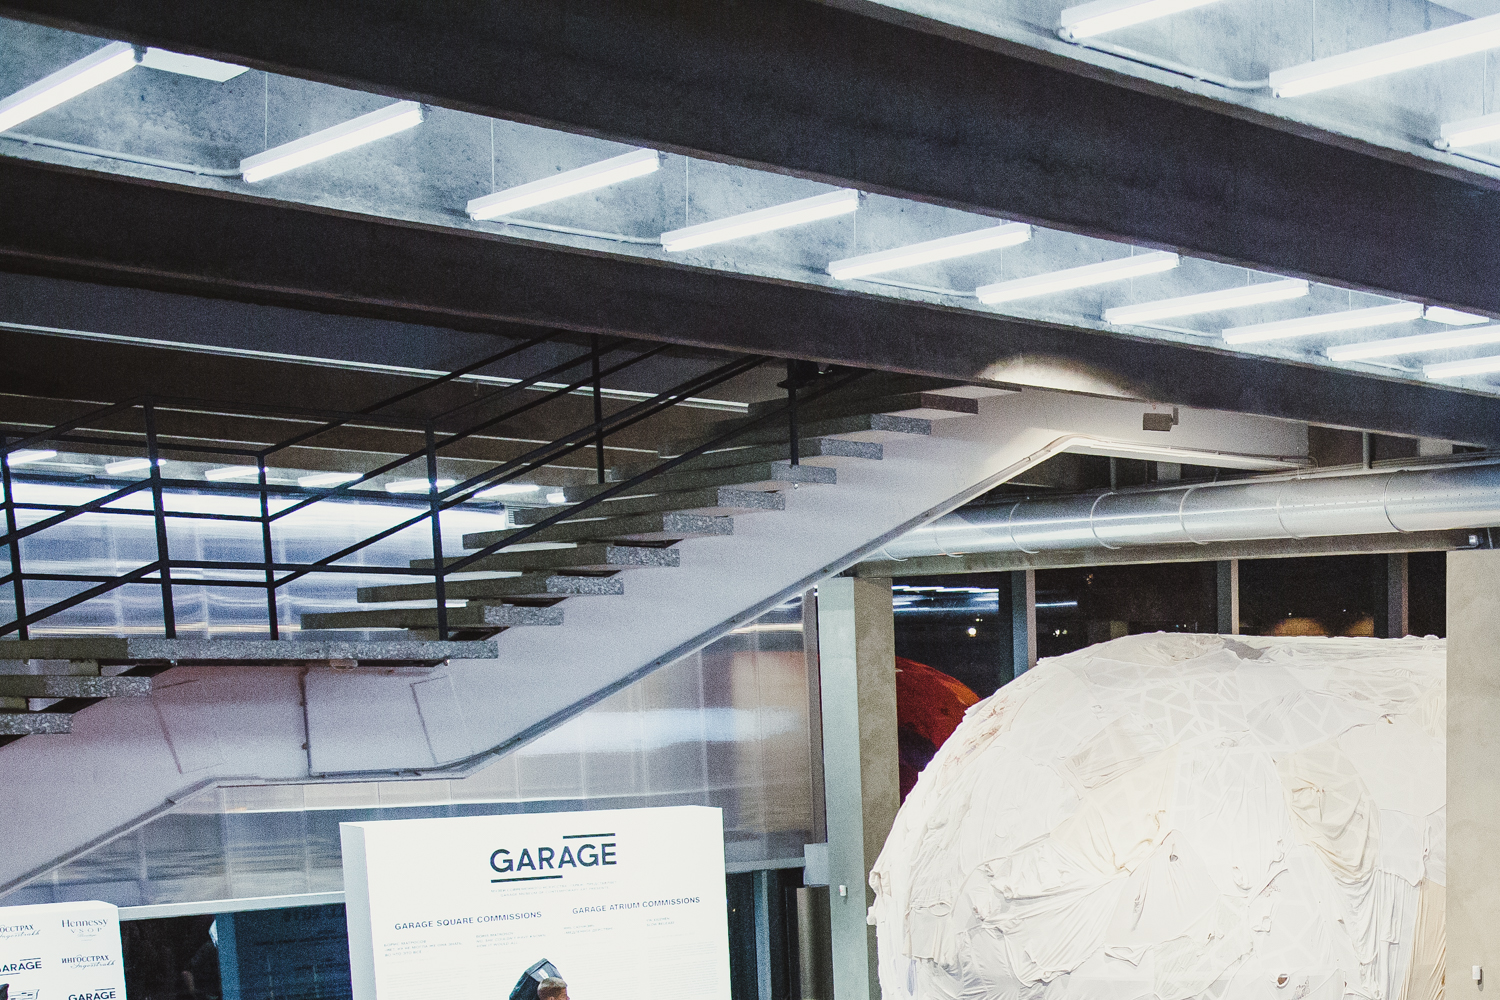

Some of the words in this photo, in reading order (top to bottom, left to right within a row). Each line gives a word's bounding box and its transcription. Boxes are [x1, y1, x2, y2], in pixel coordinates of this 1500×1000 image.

[489, 842, 617, 873] GARAGE
[572, 905, 607, 914] GARAGE
[609, 902, 640, 911] ATRIUM
[642, 896, 701, 908] COMMISSIONS
[61, 919, 108, 928] Hennessy
[394, 920, 434, 931] GARAGE
[436, 917, 474, 927] SQUARE
[476, 911, 542, 923] COMMISSIONS
[0, 924, 34, 933] ОССТРАХ
[61, 954, 109, 964] ИНГОССТРАХ
